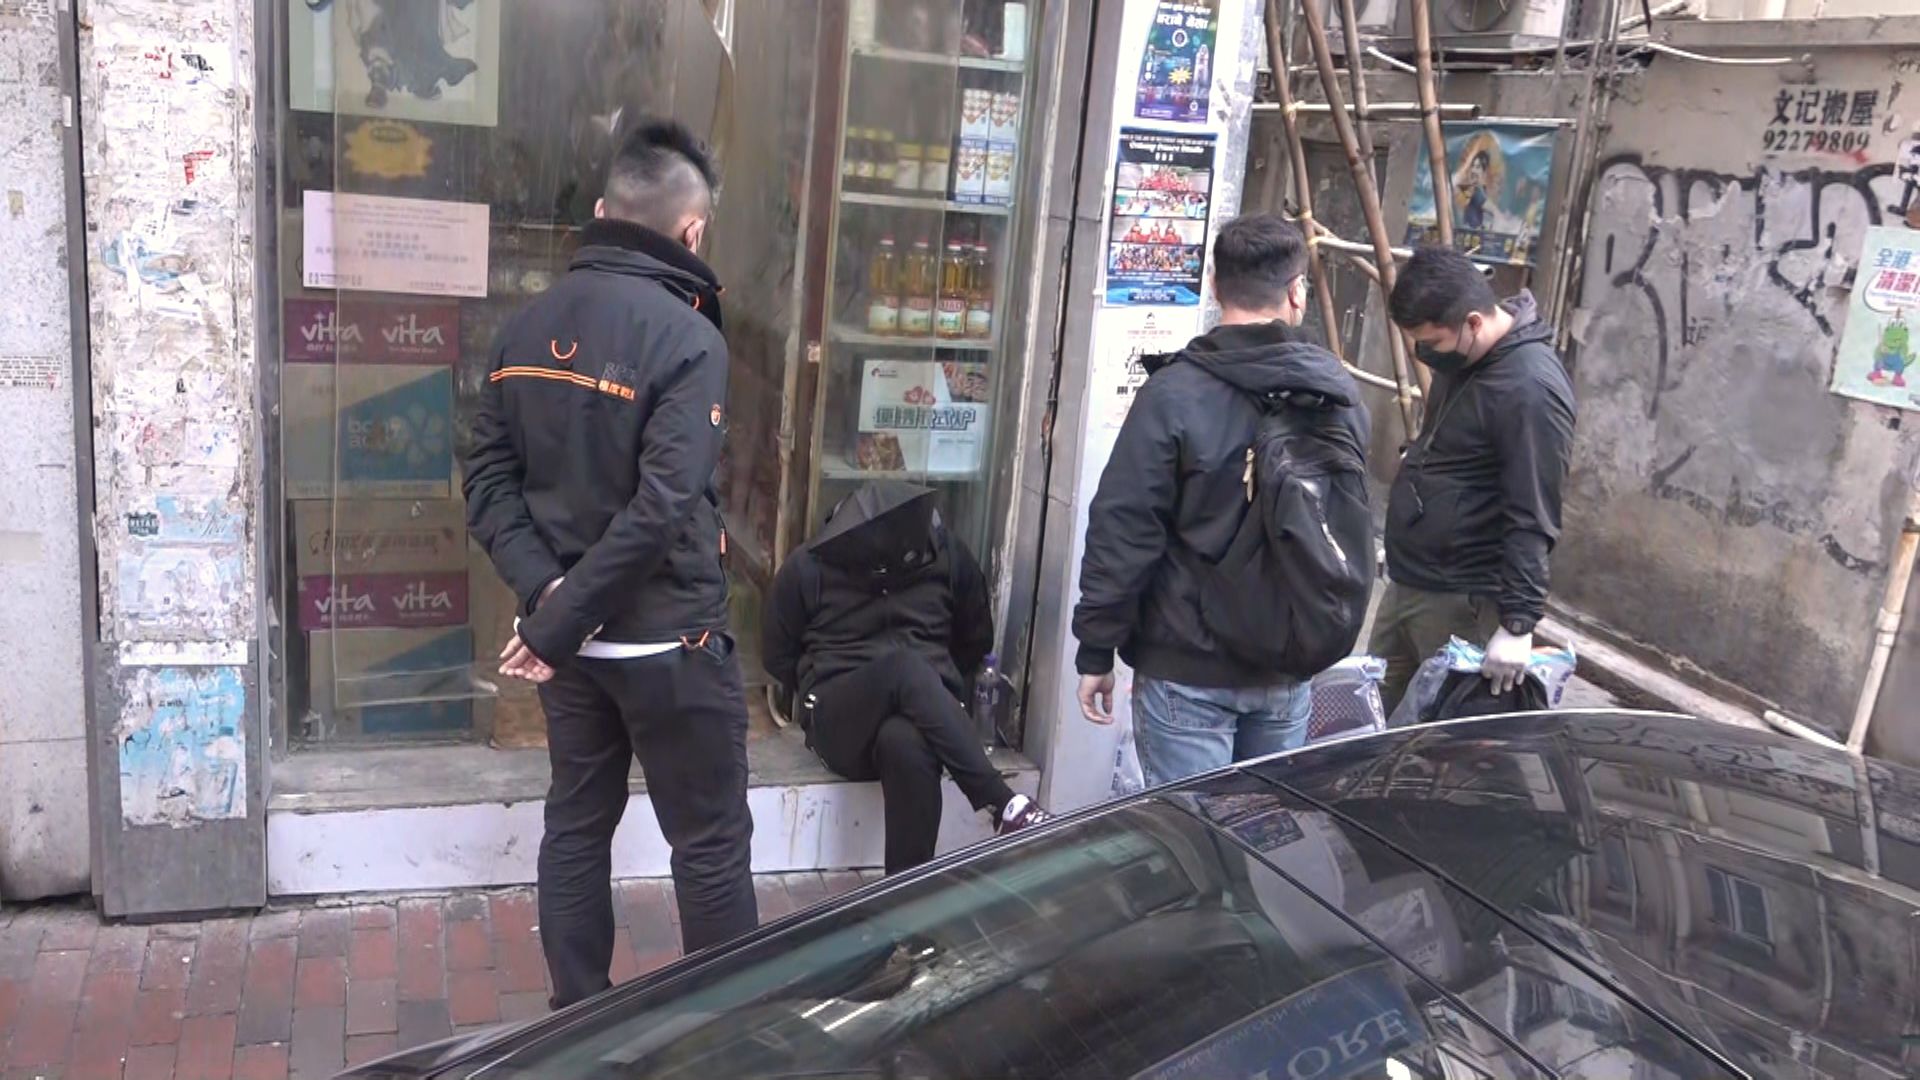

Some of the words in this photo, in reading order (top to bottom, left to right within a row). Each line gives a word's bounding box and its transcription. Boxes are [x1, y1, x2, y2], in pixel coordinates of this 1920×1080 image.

[1763, 129, 1870, 153] 92279809
[301, 311, 364, 342] vita
[382, 313, 444, 345] vita
[314, 583, 376, 613] vita
[392, 580, 452, 610] vita
